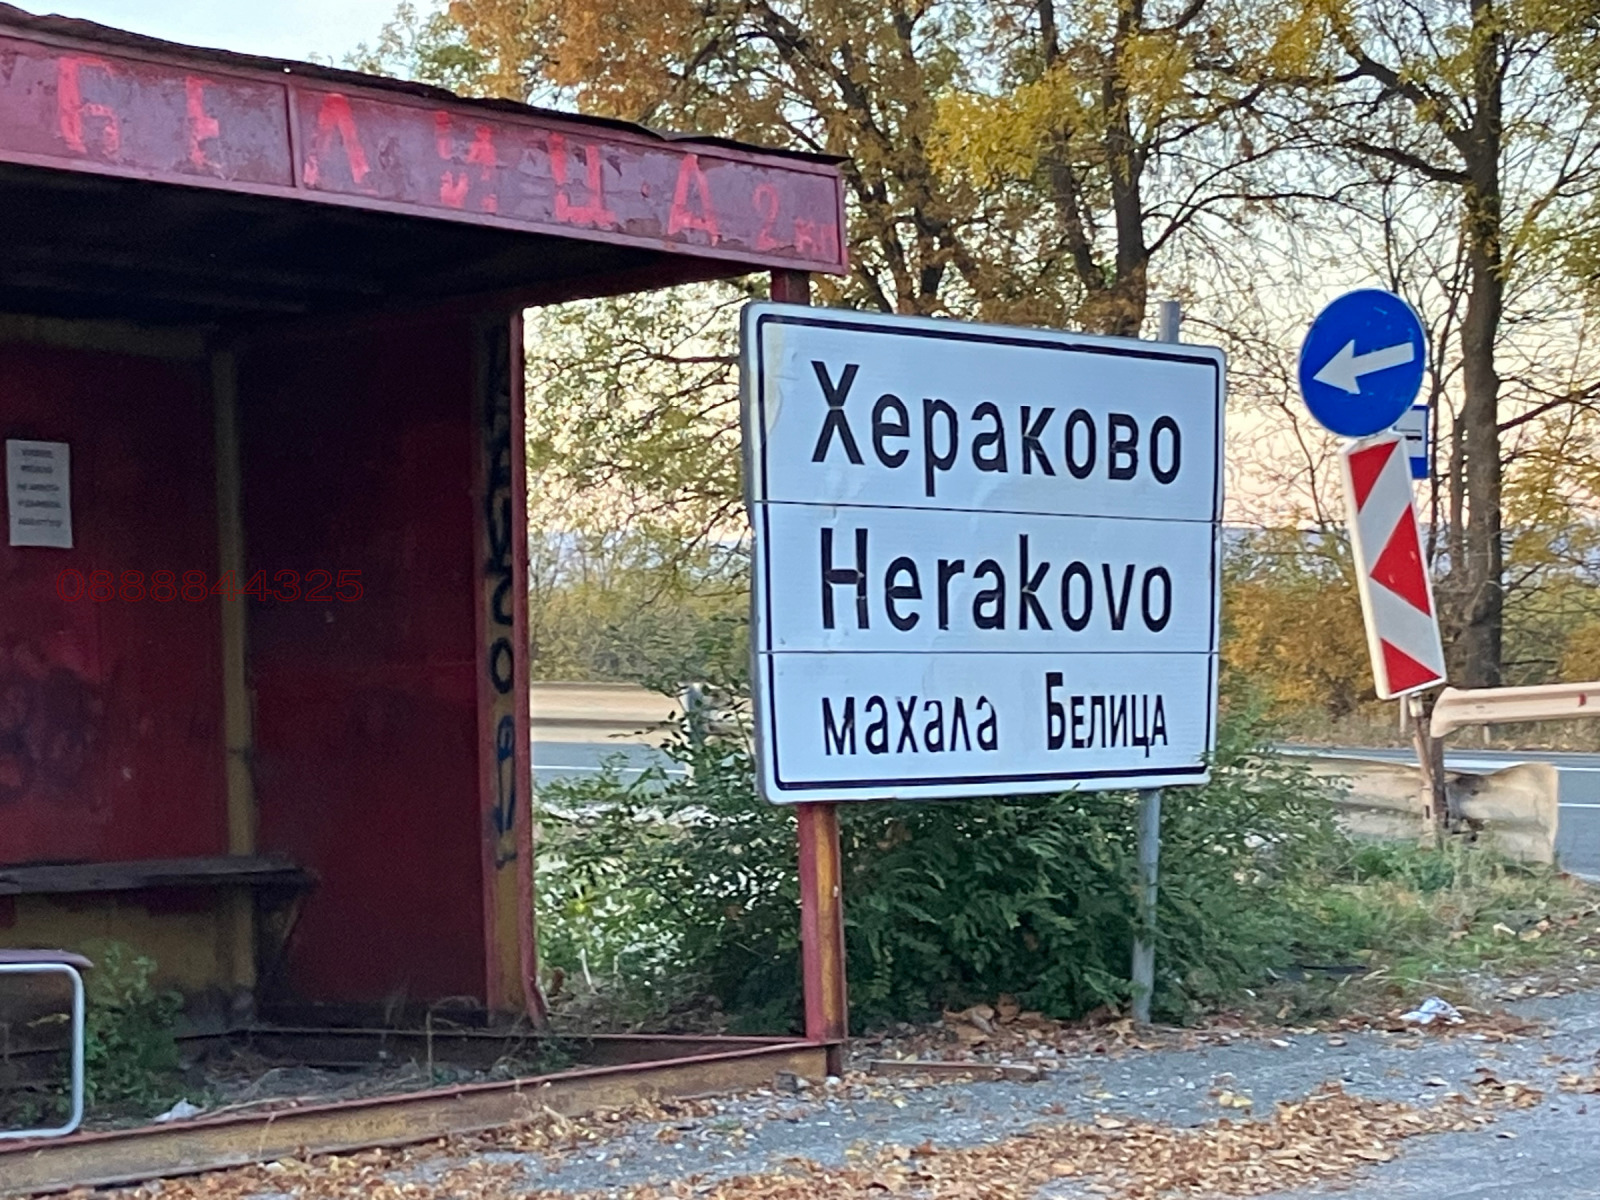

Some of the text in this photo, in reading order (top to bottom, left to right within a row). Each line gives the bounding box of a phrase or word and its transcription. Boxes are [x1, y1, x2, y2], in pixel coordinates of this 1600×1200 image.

[752, 182, 780, 250] 2
[811, 360, 1182, 497] Хераково
[820, 527, 1173, 632] Herakovo
[821, 695, 999, 756] махала
